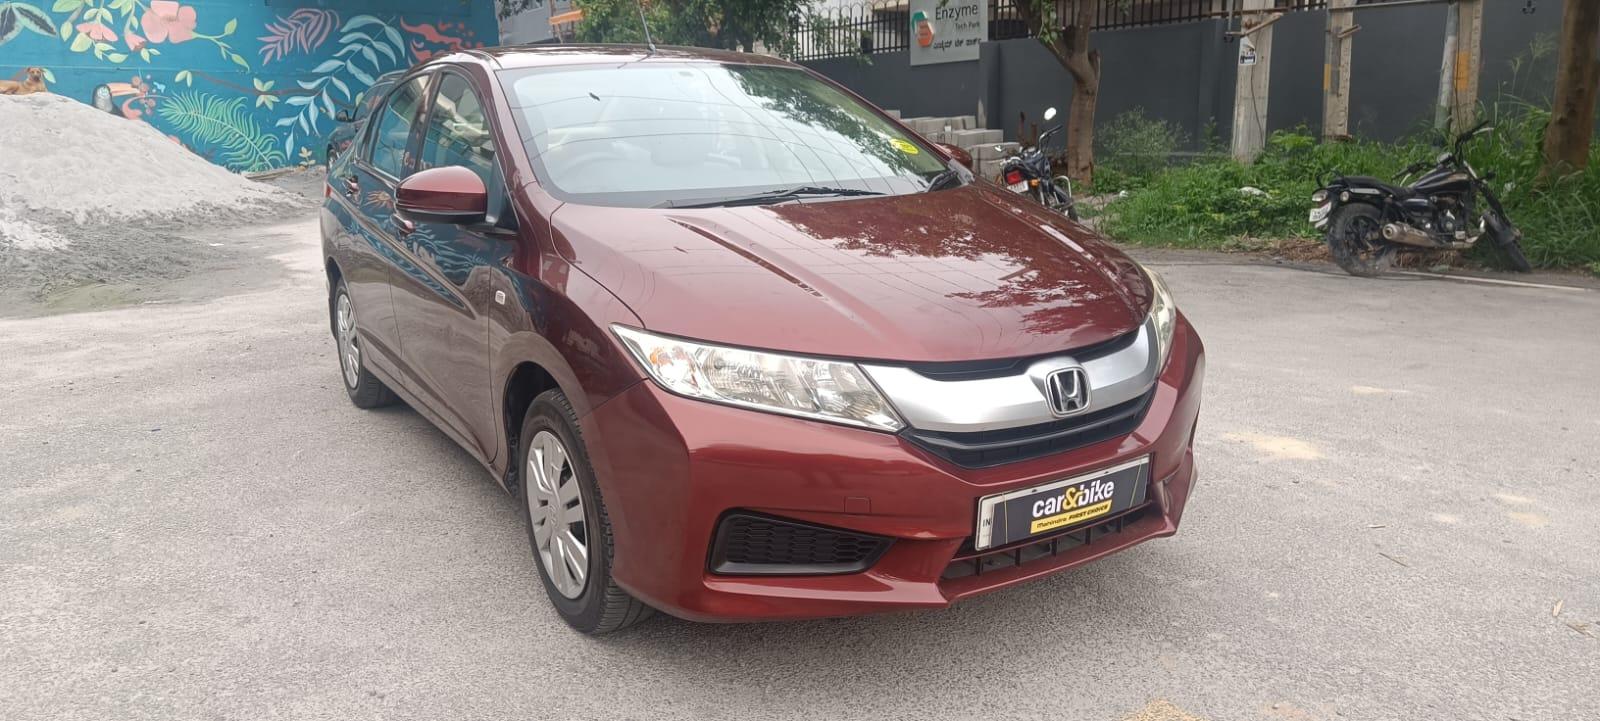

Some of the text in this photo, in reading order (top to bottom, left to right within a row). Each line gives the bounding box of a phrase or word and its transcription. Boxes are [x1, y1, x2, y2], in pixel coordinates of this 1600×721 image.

[936, 5, 978, 21] Enzyme
[1032, 480, 1114, 518] car&bike
[1087, 504, 1108, 515] CHOICE
[982, 518, 991, 527] IN
